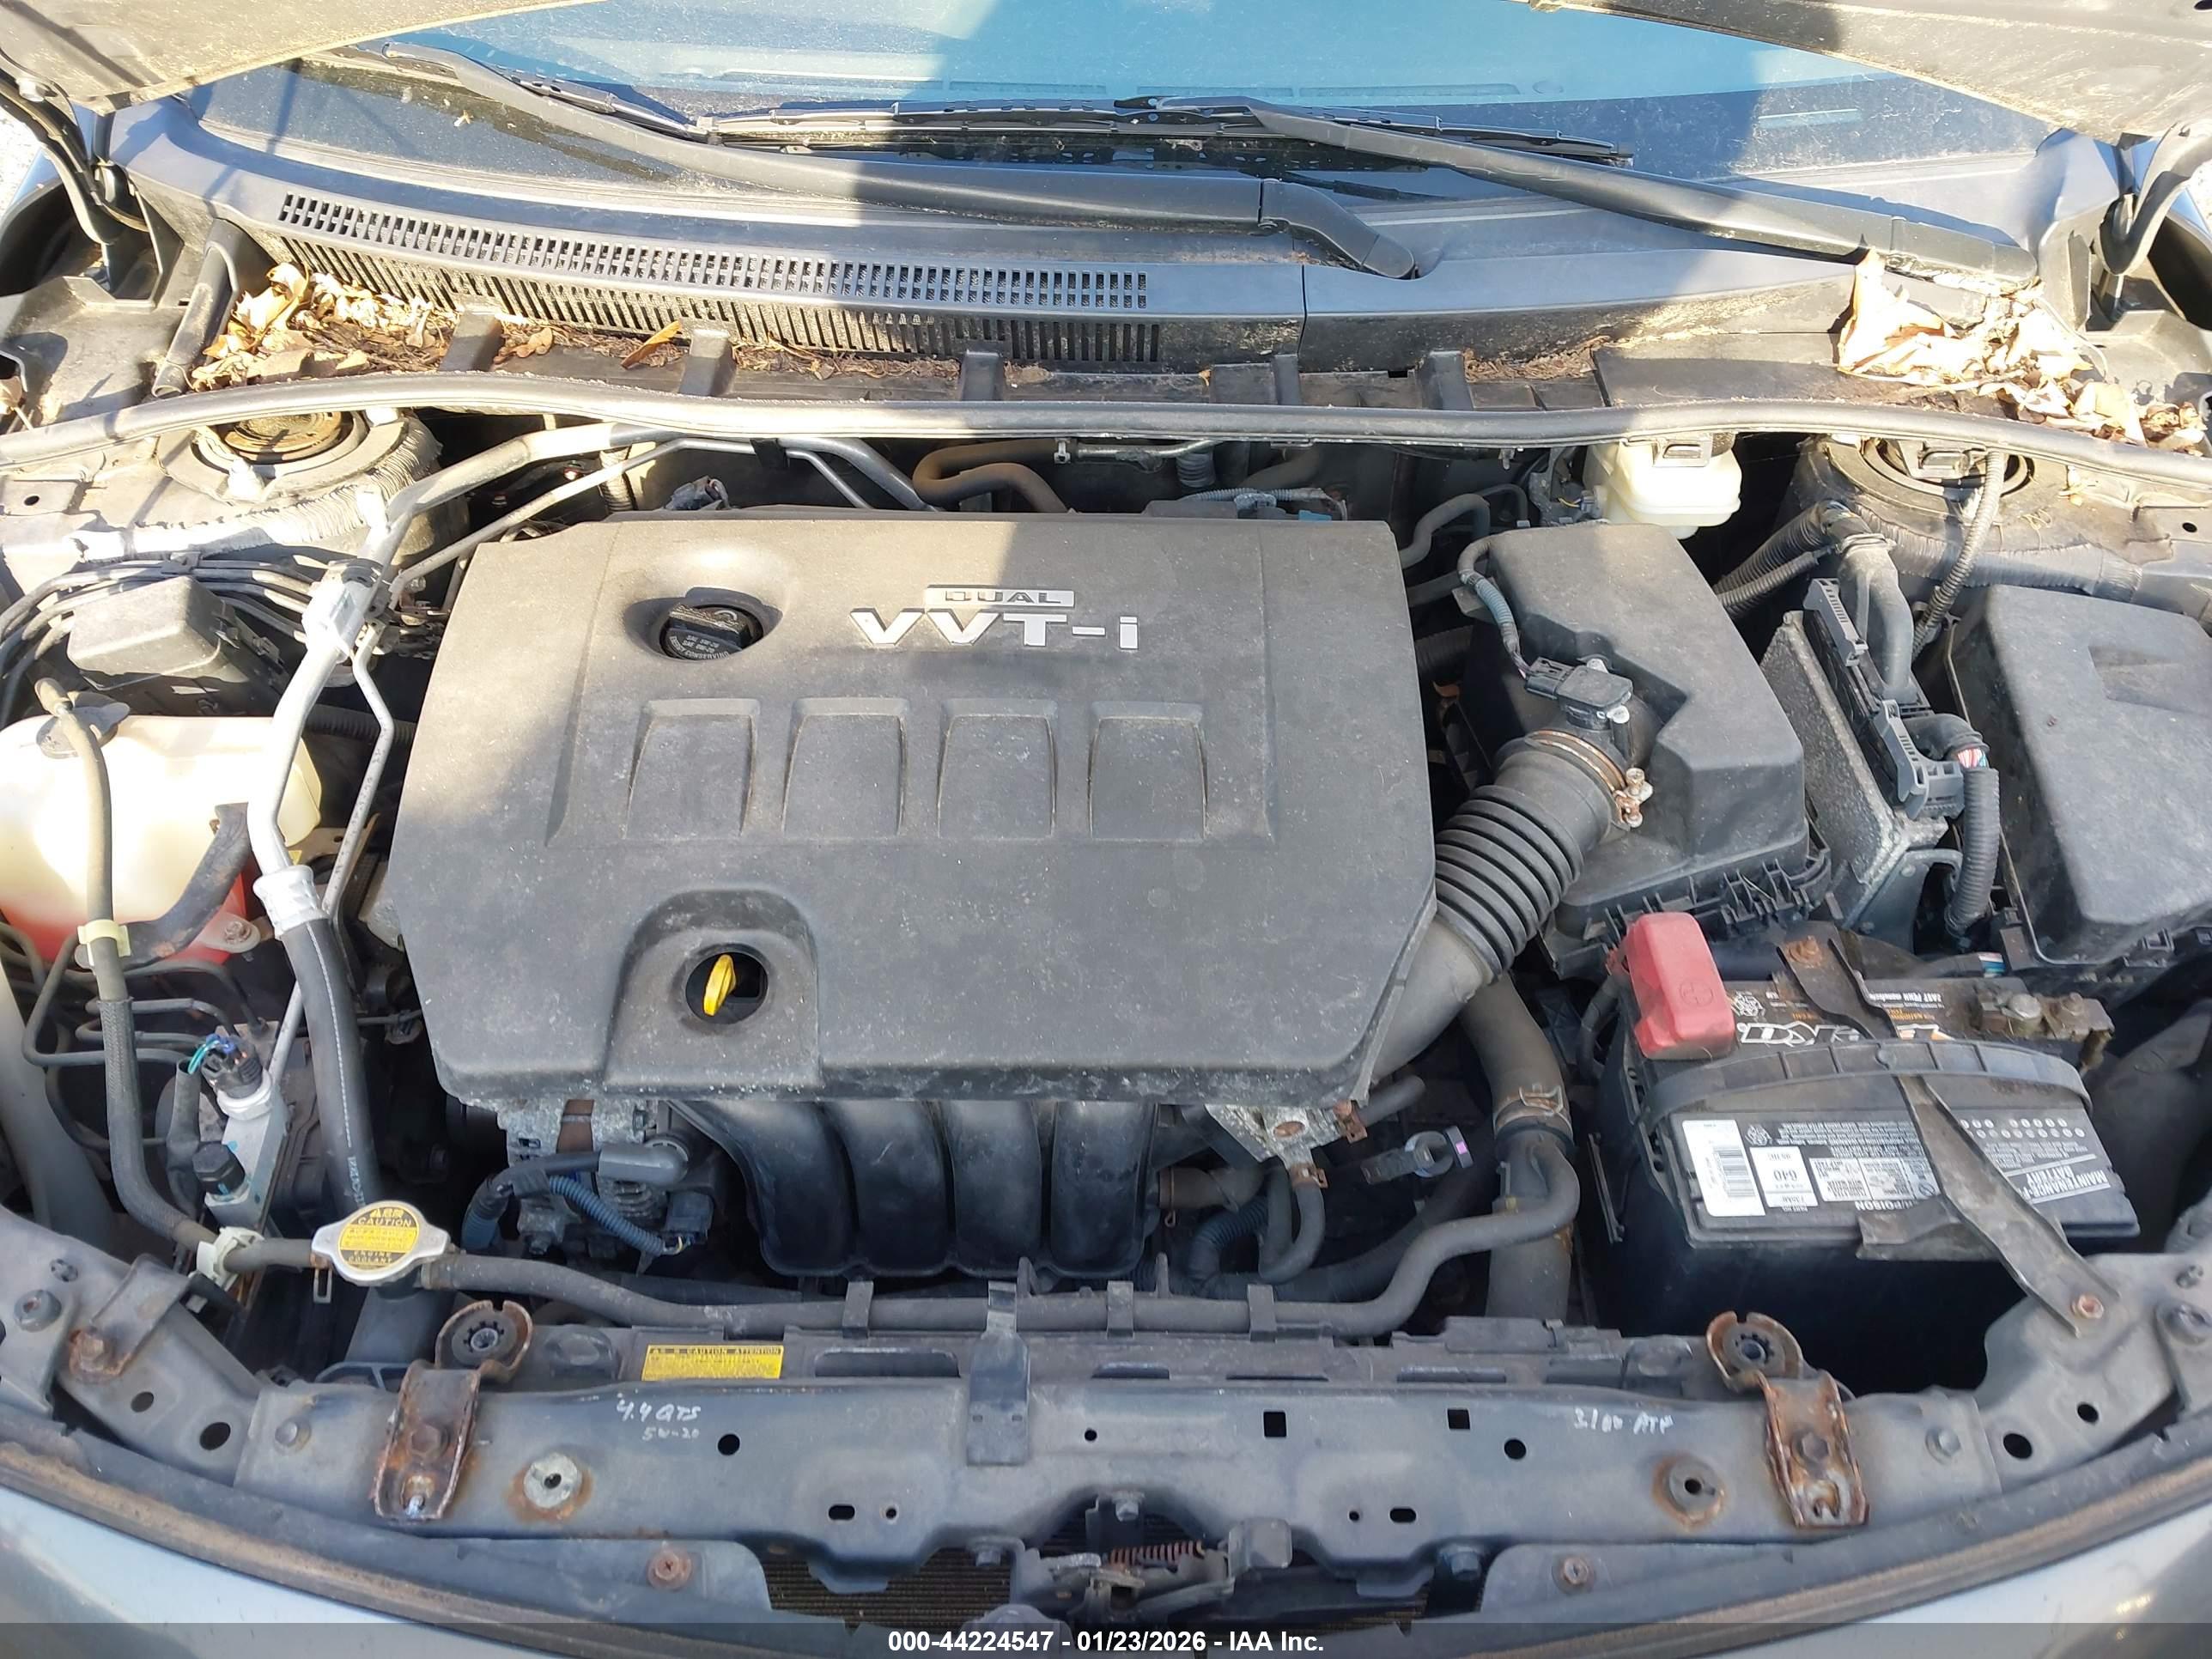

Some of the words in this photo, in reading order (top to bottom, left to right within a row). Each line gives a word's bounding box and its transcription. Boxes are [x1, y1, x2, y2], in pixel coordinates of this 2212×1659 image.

[945, 591, 1064, 604] DUAL
[849, 608, 1139, 650] VVT-i
[699, 639, 720, 648] 5W-20
[357, 1217, 412, 1227] CAUTION
[655, 1402, 702, 1423] QTS
